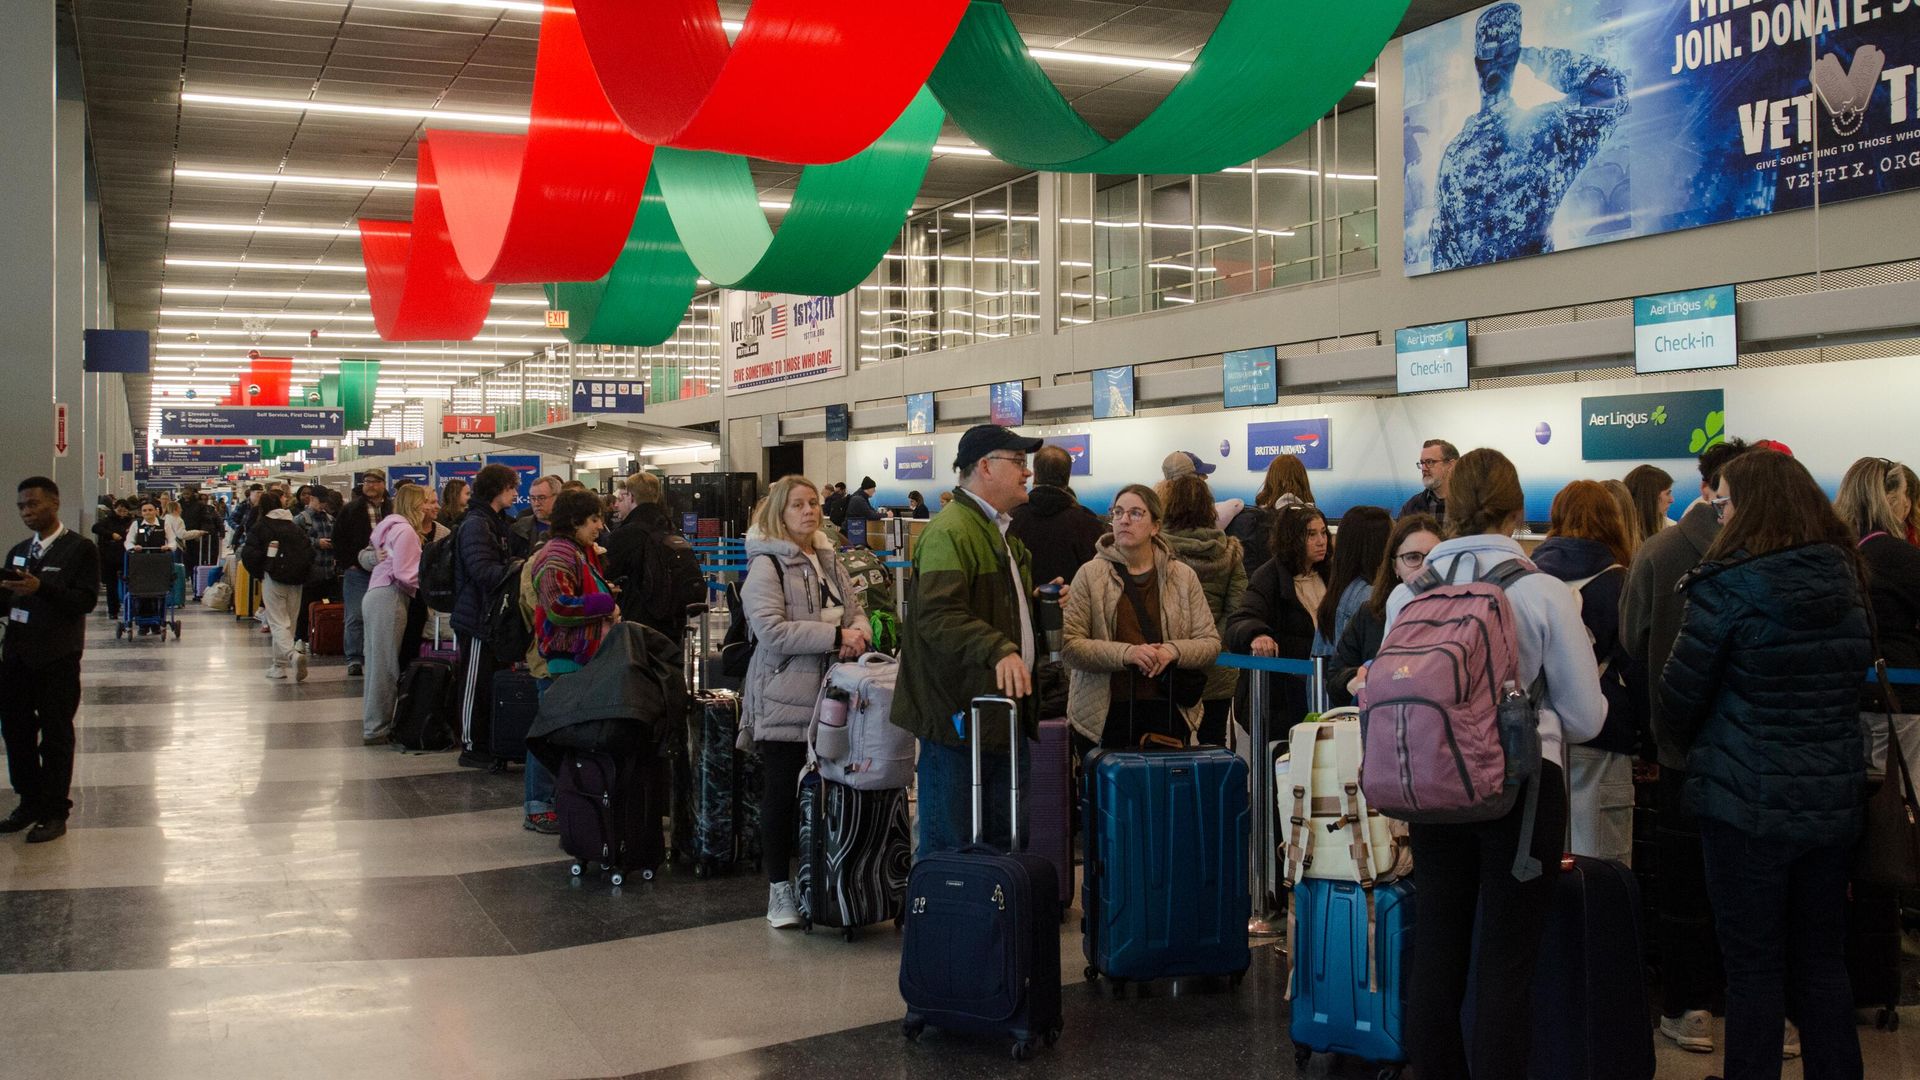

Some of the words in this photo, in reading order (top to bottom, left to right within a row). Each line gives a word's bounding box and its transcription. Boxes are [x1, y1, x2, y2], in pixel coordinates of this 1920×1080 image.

[1672, 20, 1742, 74] JOIN.
[1738, 93, 1814, 155] VET
[1756, 160, 1777, 170] GIVE
[1780, 147, 1837, 166] SOMETHING
[1841, 143, 1855, 153] TO
[1858, 135, 1892, 149] THOSE
[1650, 304, 1667, 316] Aer
[1668, 301, 1701, 315] Lingus
[547, 311, 565, 324] EXIT
[730, 321, 743, 342] VET
[752, 315, 765, 336] TIX
[1407, 335, 1420, 345] Aer
[1420, 332, 1443, 345] Lingus
[1655, 331, 1714, 353] Check-in
[734, 368, 745, 383] GIVE
[746, 362, 774, 380] SOMETHING
[775, 360, 782, 374] TO
[784, 356, 800, 373] THOSE
[802, 352, 816, 369] WHO
[817, 349, 832, 366] GAVE
[1410, 360, 1452, 377] Check-in
[575, 382, 586, 395] A
[474, 419, 482, 429] 7
[1589, 413, 1609, 427] Aer
[1610, 411, 1648, 429] Lingus
[1255, 446, 1279, 456] BRITISH
[1280, 444, 1306, 456] AIRWAYS
